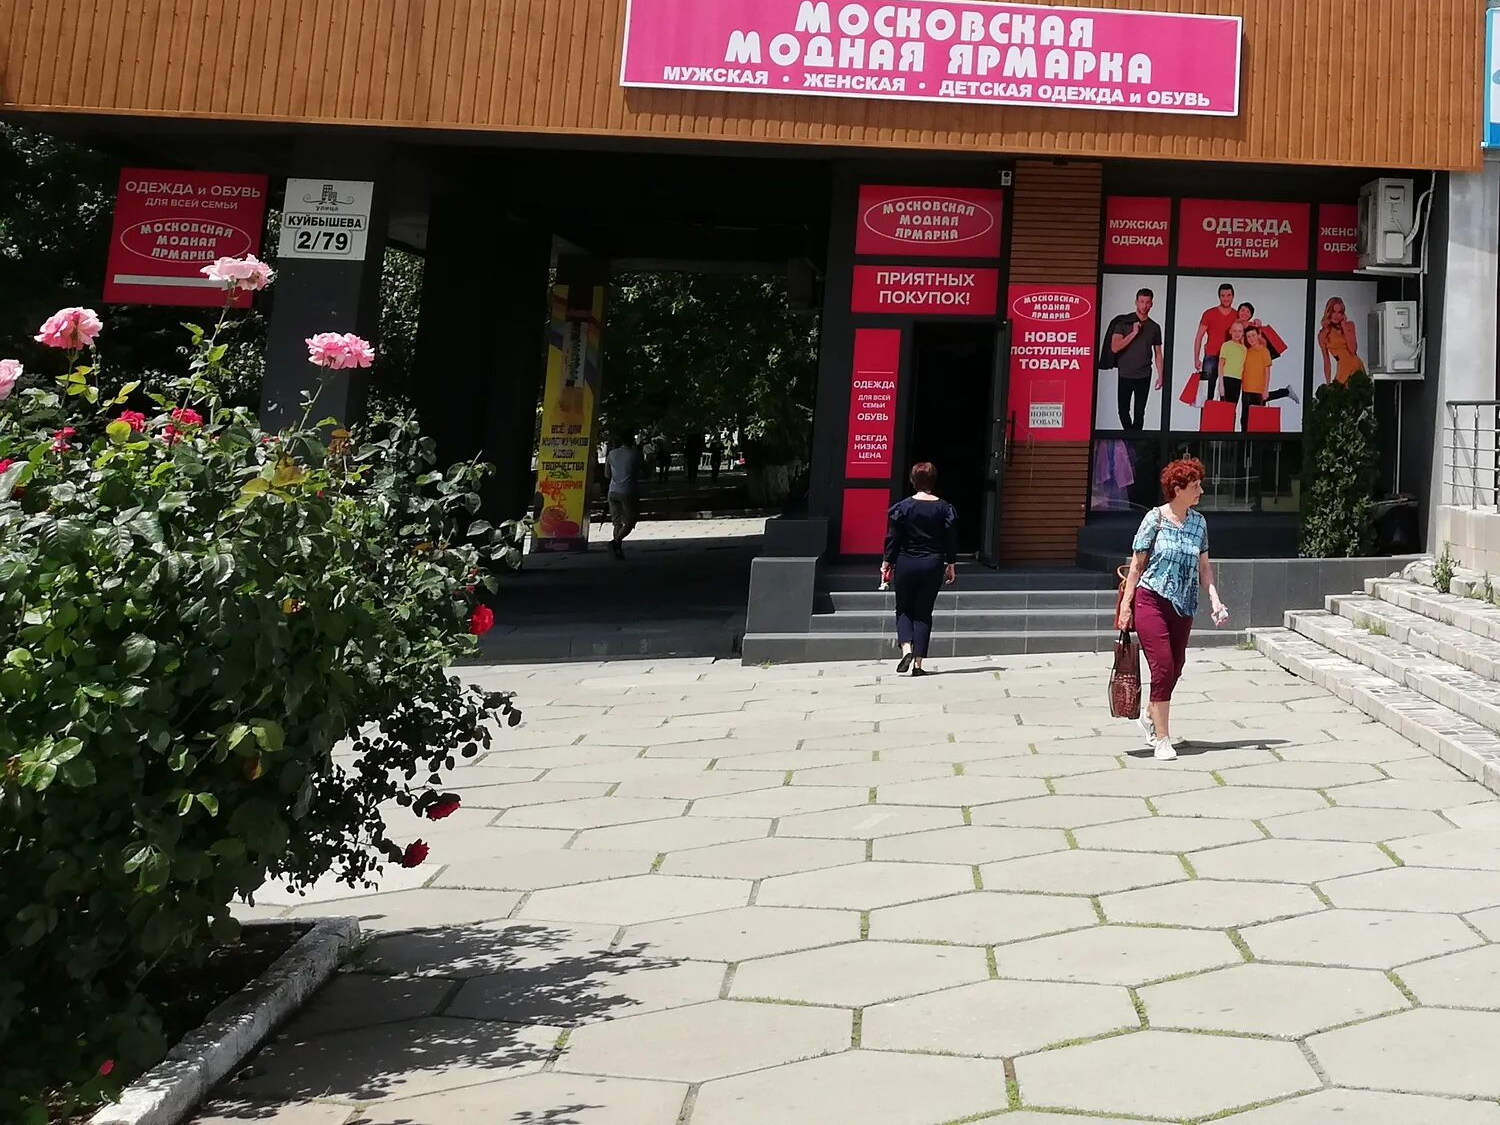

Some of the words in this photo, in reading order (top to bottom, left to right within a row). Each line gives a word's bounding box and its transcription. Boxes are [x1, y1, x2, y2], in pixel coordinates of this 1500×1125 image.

[795, 1, 1094, 49] МОСКОВСКАЯ
[725, 30, 924, 72] МОДНАЯ
[948, 41, 1152, 84] ЯРМАРКА
[663, 66, 769, 85] МУЖСКАЯ
[803, 71, 906, 92] ЖЕНСКАЯ
[939, 78, 1032, 99] ДЕТСКАЯ
[1037, 84, 1124, 105] ОДЕЖДА
[1130, 92, 1142, 103] и
[1147, 90, 1211, 108] ОБУВЬ
[125, 181, 193, 195] ОДЕЖДА
[211, 186, 261, 198] ОБУВЬ
[145, 198, 168, 207] ДЛЯ
[171, 198, 198, 208] ВСЕЙ
[201, 200, 238, 210] СЕМЬИ
[288, 213, 362, 228] КУЙБЫШЕВА
[1109, 220, 1168, 230] МУЖСКАЯ
[1203, 217, 1292, 235] ОДЕЖДА
[297, 232, 348, 250] 2/79
[1112, 235, 1163, 246] ОДЕЖДА
[1216, 237, 1242, 248] ДЛЯ
[1245, 237, 1279, 248] ВСЕЙ
[1225, 248, 1268, 258] СЕМЬИ
[877, 272, 975, 287] ПРИЯТНЫХ
[879, 291, 970, 305] ПОКУПОК!
[1025, 332, 1077, 342] НОВОЕ
[1011, 347, 1090, 355] ПОСТУПЛЕНИЕ
[1019, 359, 1079, 369] ТОВАРА
[854, 380, 895, 389] ОДЕЖДА
[857, 413, 888, 421] ОБУВЬ
